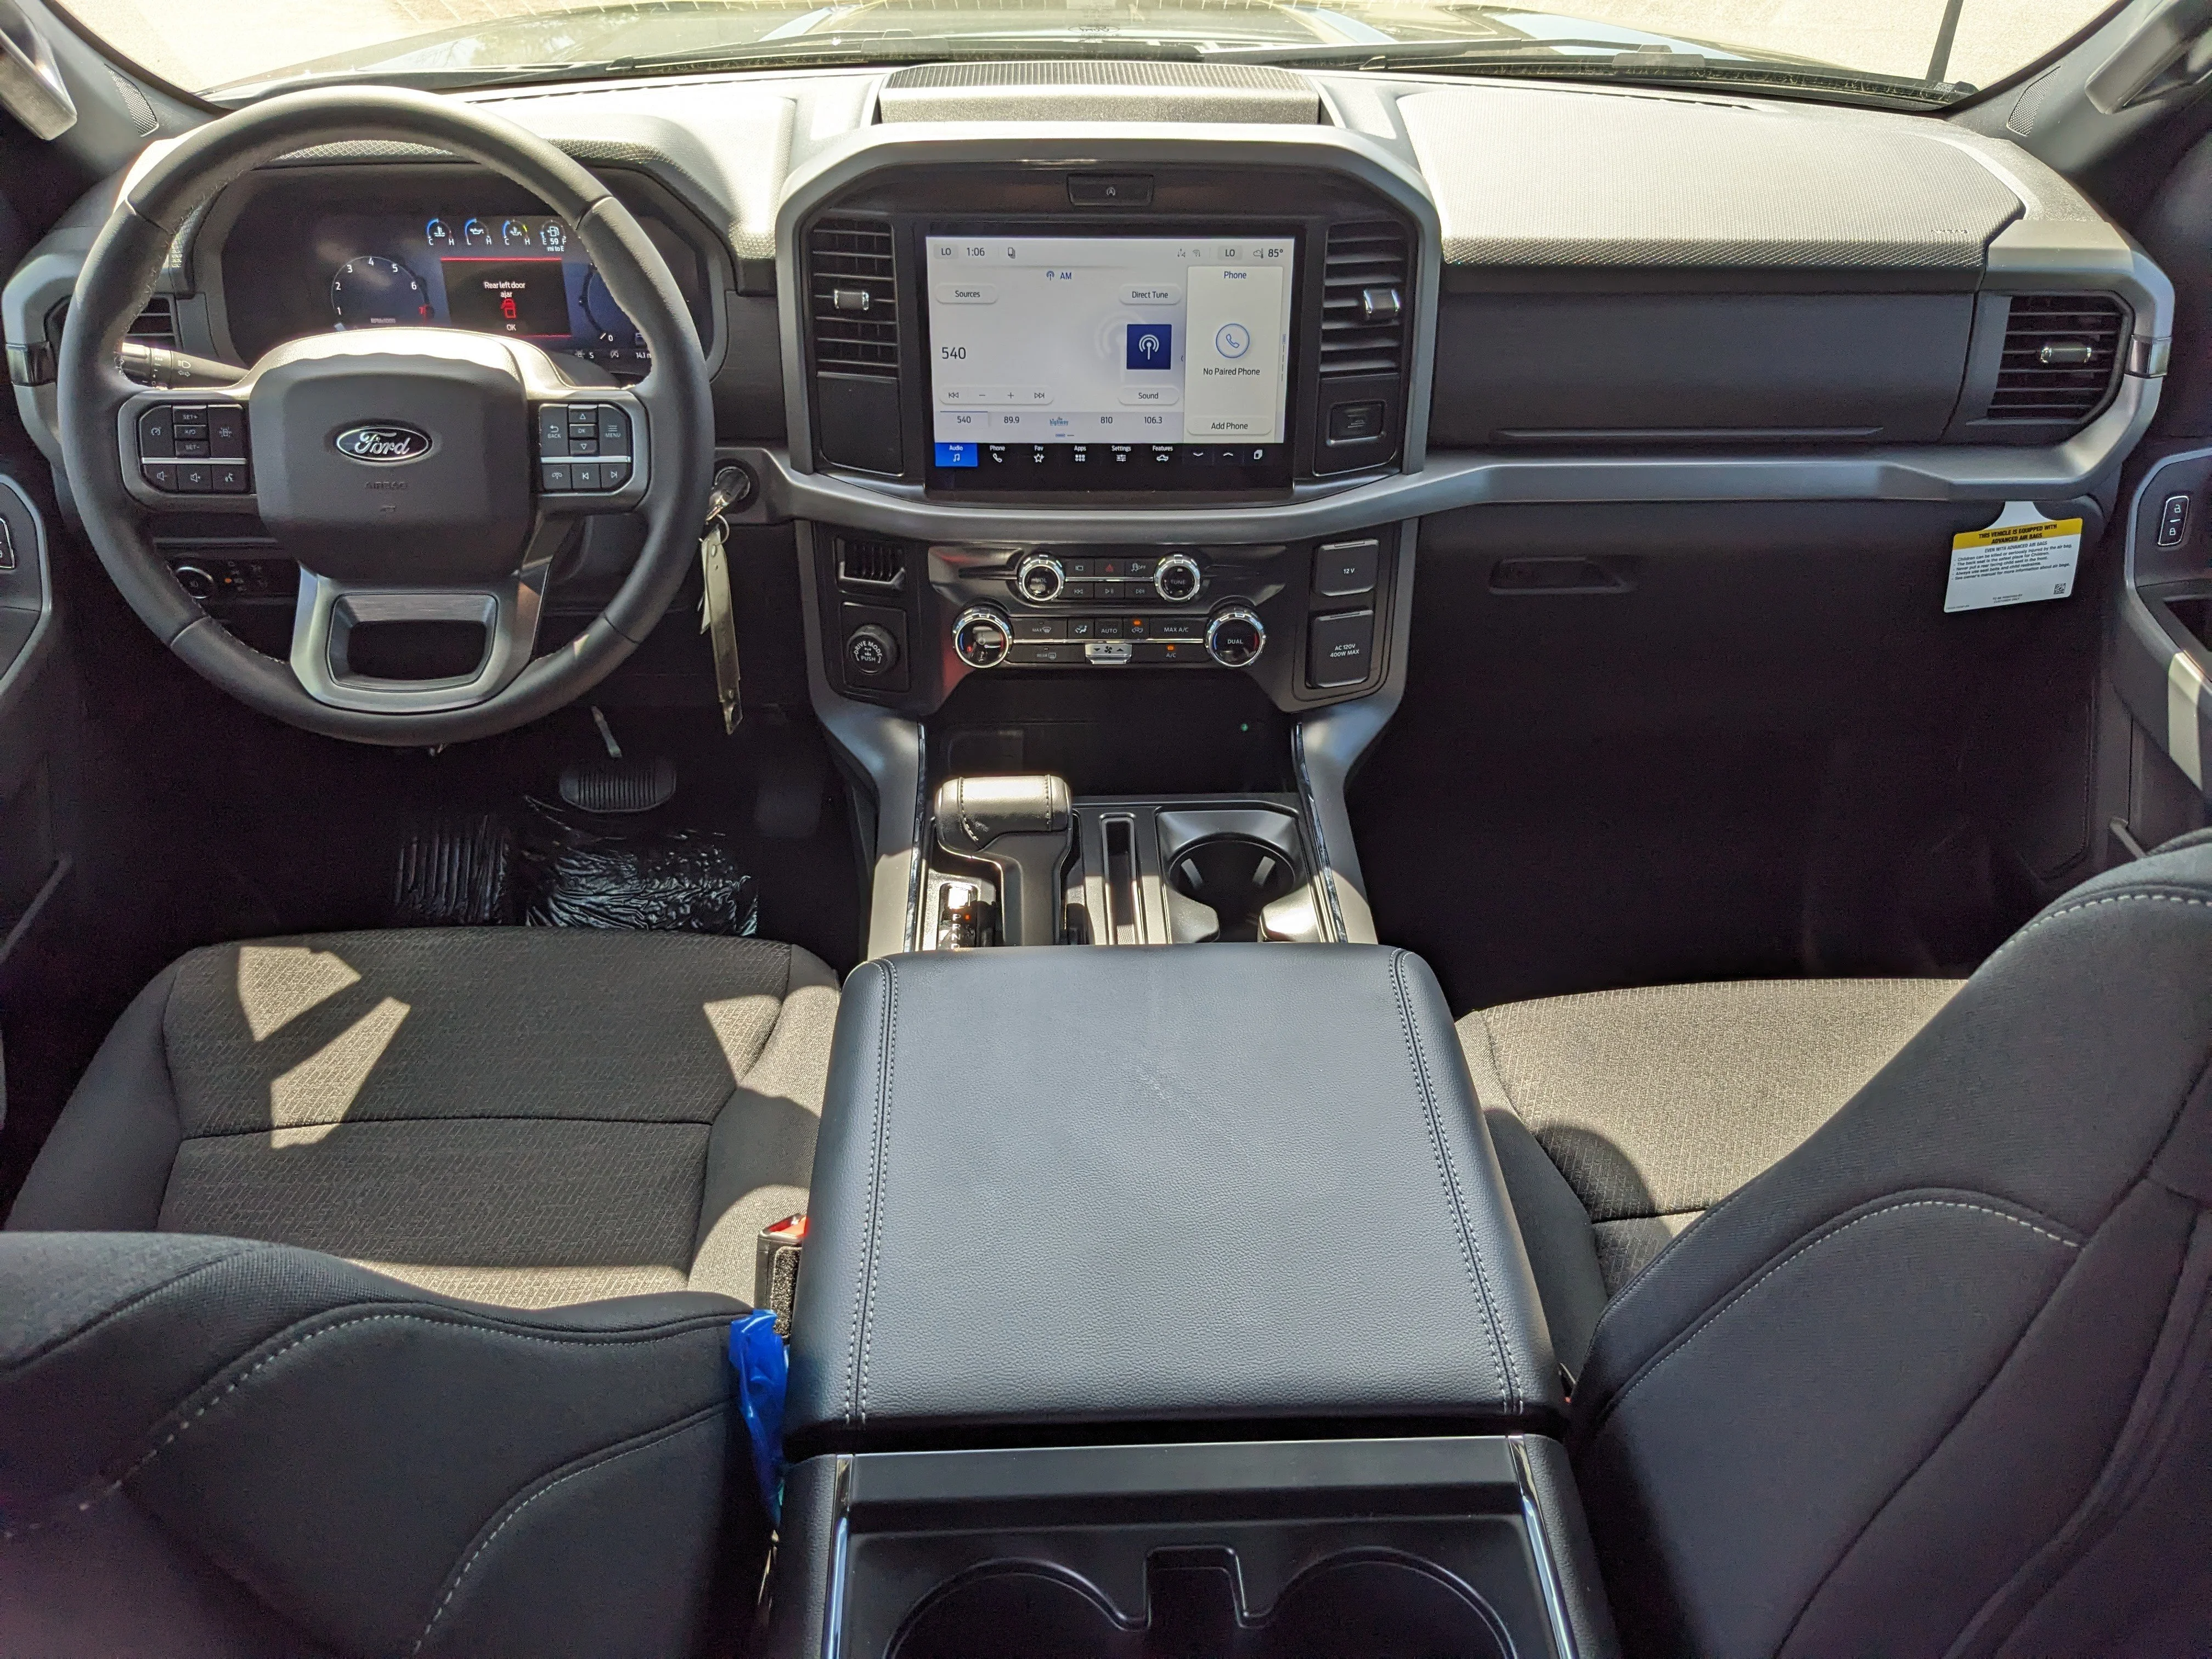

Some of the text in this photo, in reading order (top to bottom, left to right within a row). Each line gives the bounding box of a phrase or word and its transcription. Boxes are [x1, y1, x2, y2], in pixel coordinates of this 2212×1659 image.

[941, 248, 952, 256] LO
[966, 248, 985, 256] 1:06
[1267, 249, 1283, 257] 85°
[1223, 271, 1247, 279] Phone
[941, 347, 966, 360] 540
[1214, 368, 1235, 376] Paired
[1237, 368, 1260, 376] Phone
[1138, 392, 1159, 400] Sound
[1049, 418, 1069, 426] highway
[1211, 422, 1248, 430] Add Phone
[356, 431, 410, 454] Ford
[1111, 445, 1131, 453] Settings
[854, 641, 883, 657] DRIVE MODE
